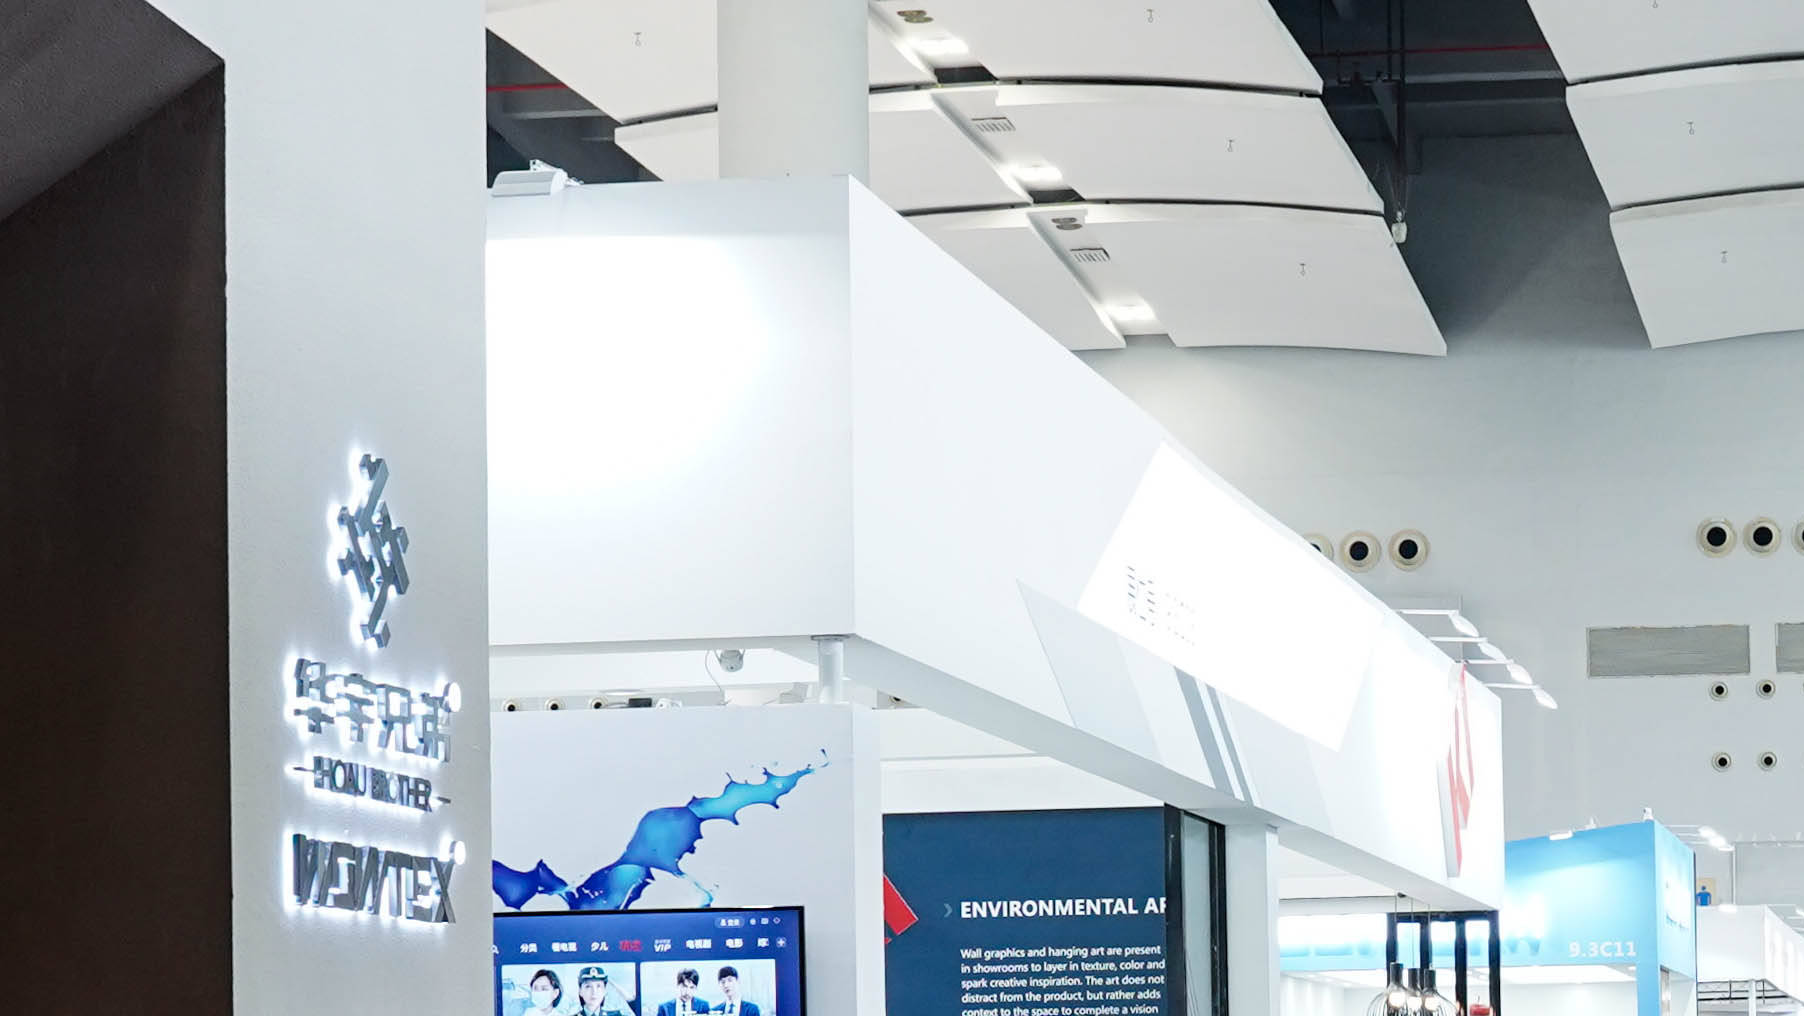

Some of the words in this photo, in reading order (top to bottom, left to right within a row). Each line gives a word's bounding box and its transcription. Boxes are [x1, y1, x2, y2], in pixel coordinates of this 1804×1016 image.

[960, 898, 1139, 919] ENVIRONMENTAL
[961, 948, 981, 959] Wall
[984, 947, 1025, 960] graphics
[1028, 946, 1046, 957] and
[1048, 946, 1088, 959] hanging
[1091, 945, 1104, 956] art
[1107, 947, 1122, 956] are
[1125, 944, 1161, 957] present
[1568, 940, 1638, 959] 9.3C11
[961, 962, 970, 973] in
[973, 962, 1028, 973] showrooms
[1031, 961, 1041, 972] to
[1044, 960, 1067, 973] layer
[1070, 960, 1079, 971] in
[1081, 960, 1117, 973] texture,
[1120, 959, 1144, 970] color
[1147, 958, 1165, 969] and
[962, 977, 987, 990] spark
[990, 976, 1027, 987] creative
[1030, 975, 1082, 988] inspiration.
[1085, 975, 1103, 986] The
[1106, 975, 1119, 986] art
[1122, 974, 1145, 985] does
[1148, 974, 1164, 985] not
[962, 992, 998, 1003] distract
[1000, 991, 1023, 1002] from
[1026, 991, 1041, 1002] the
[1044, 990, 1084, 1003] product,
[1087, 990, 1103, 1001] but
[1106, 989, 1135, 1000] rather
[1137, 989, 1160, 1000] adds
[1000, 1006, 1011, 1016] to
[1014, 1006, 1029, 1016] the
[1062, 1005, 1071, 1016] to
[1122, 1006, 1128, 1015] a
[1130, 1004, 1158, 1015] vision
